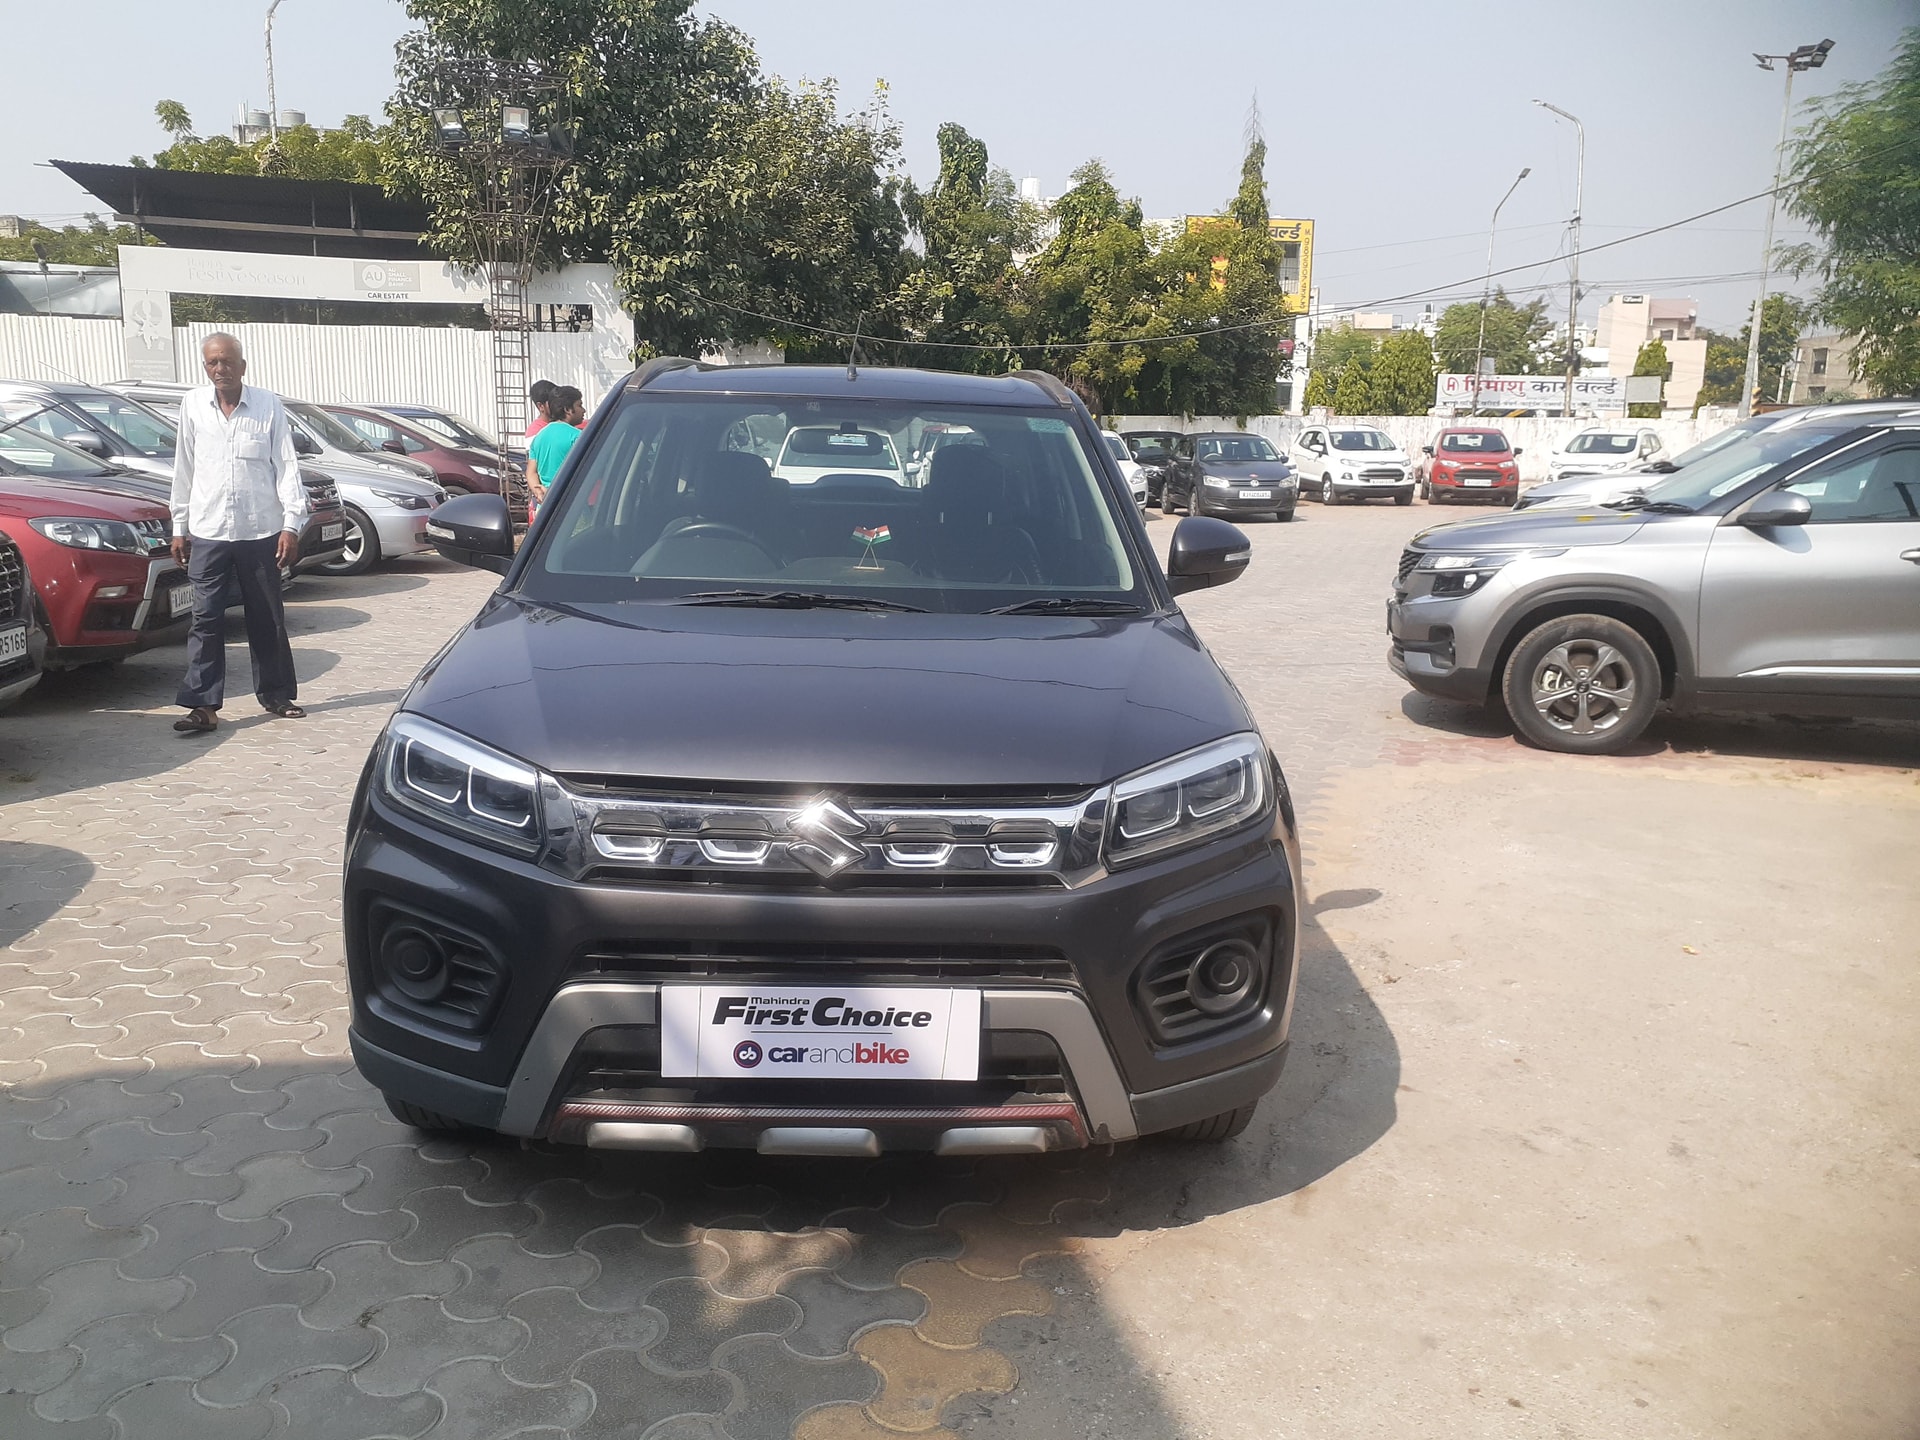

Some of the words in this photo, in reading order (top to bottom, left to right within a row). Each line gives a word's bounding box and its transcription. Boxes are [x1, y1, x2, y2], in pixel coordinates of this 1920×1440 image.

[364, 271, 383, 281] AU
[1573, 377, 1618, 394] वर्ल्ड
[751, 996, 810, 1005] Mahindra
[712, 996, 811, 1025] First
[812, 997, 933, 1027] Choice
